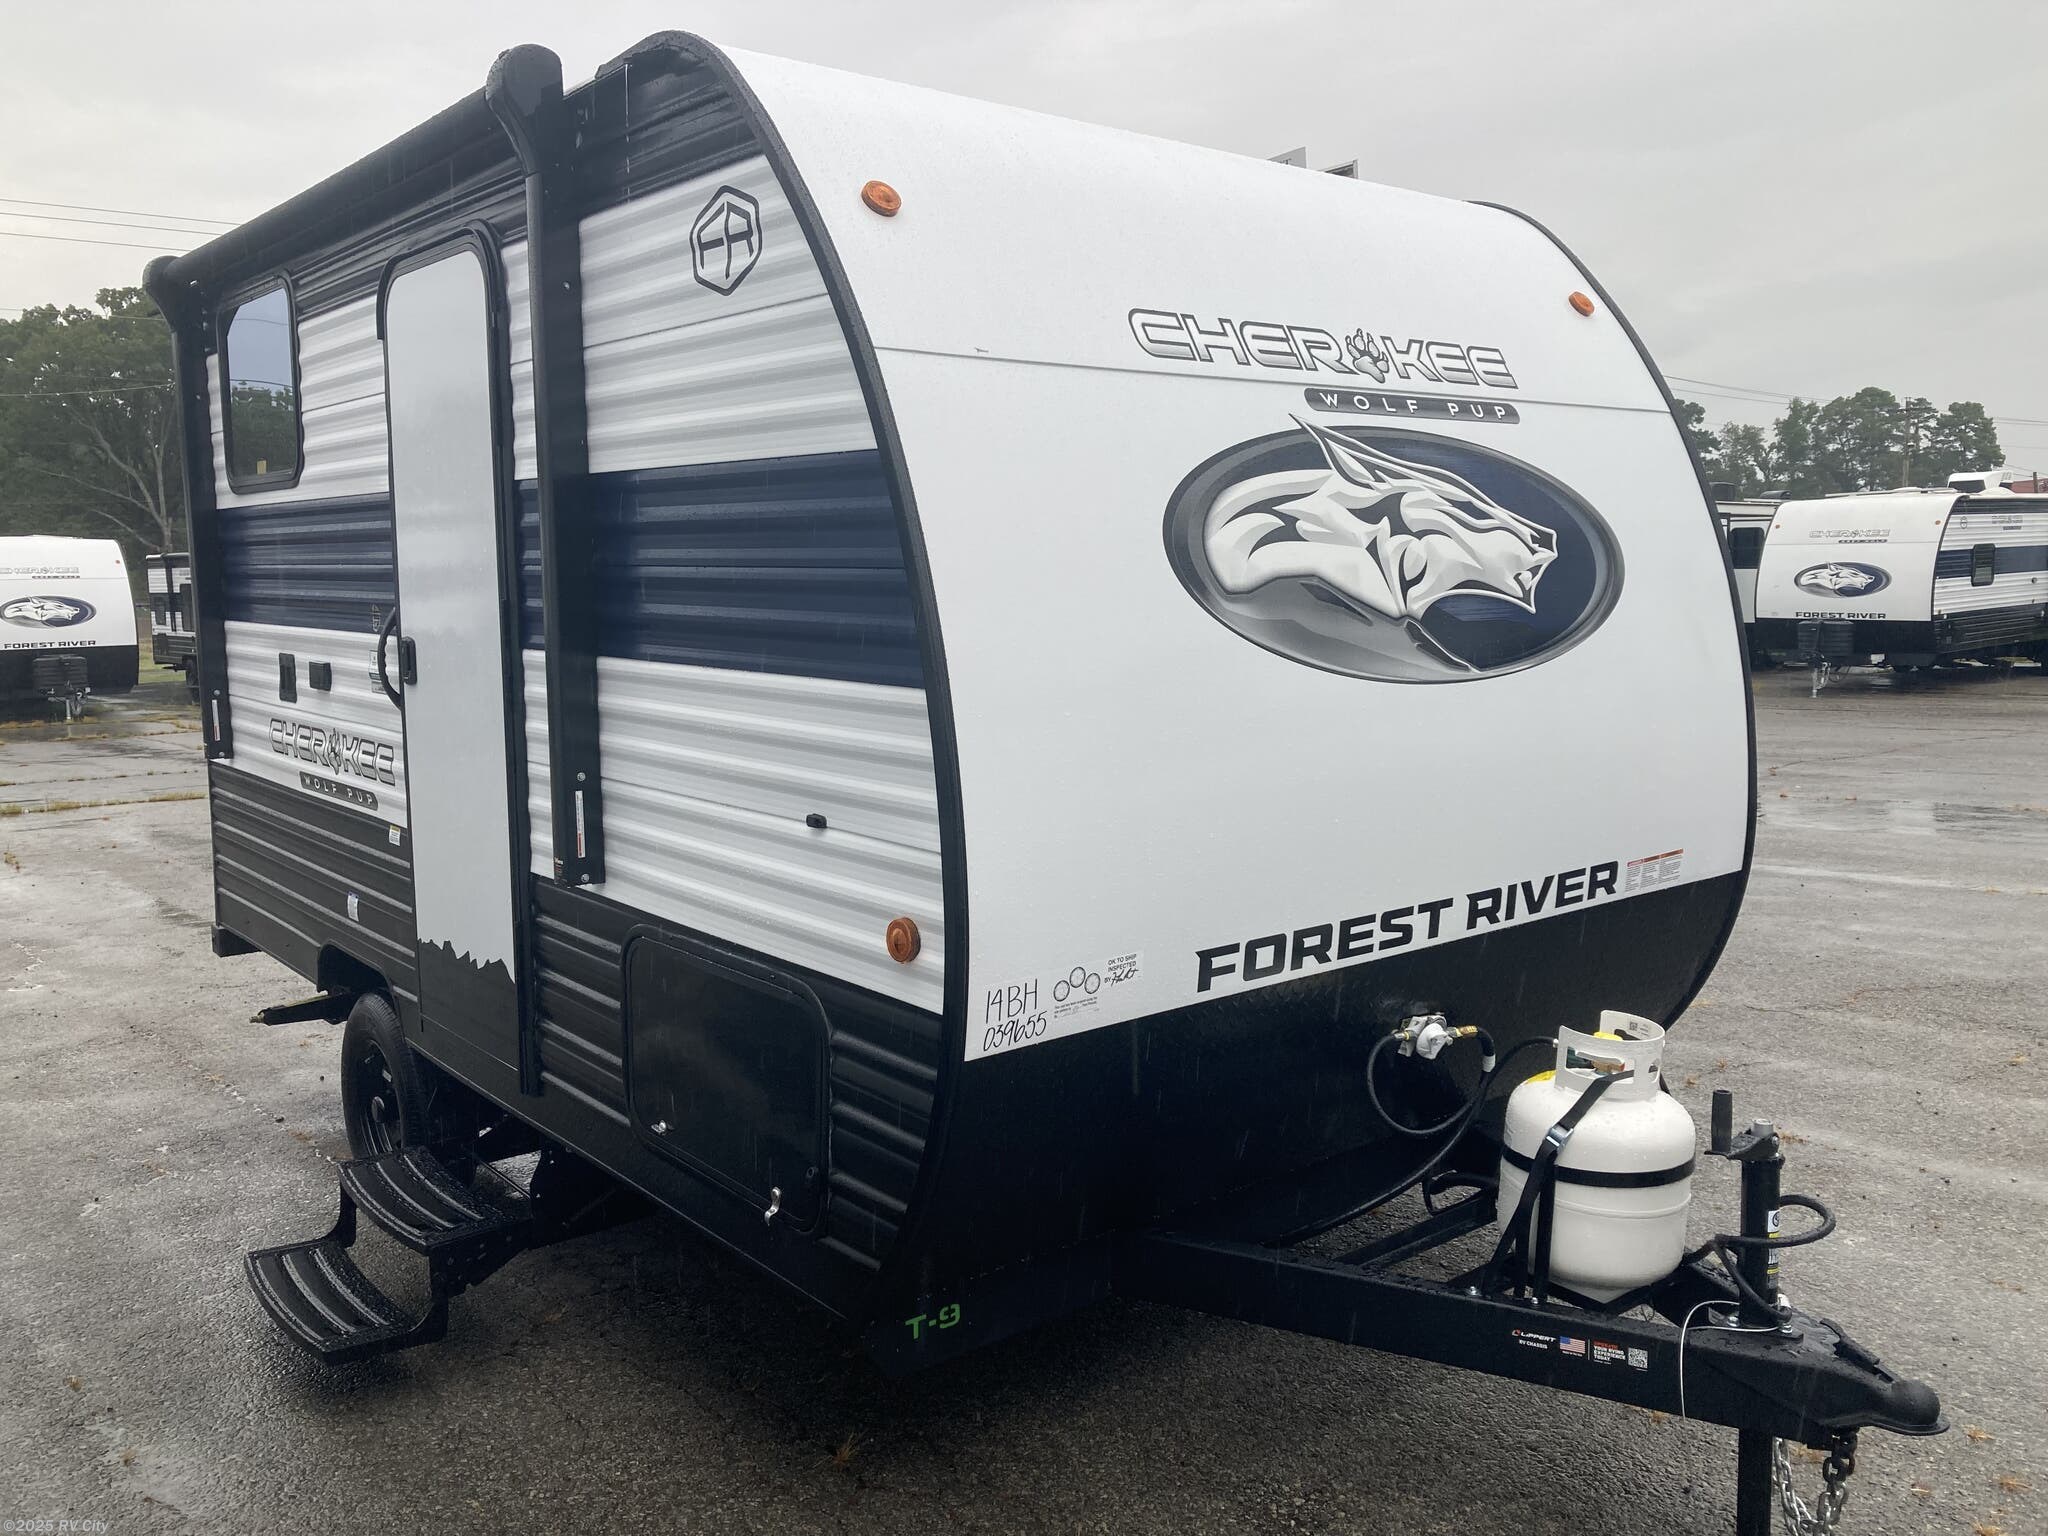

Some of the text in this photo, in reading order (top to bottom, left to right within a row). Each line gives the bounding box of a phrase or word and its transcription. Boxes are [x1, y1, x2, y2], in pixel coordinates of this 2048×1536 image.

[1128, 308, 1519, 390] CHEROKEE
[1319, 392, 1506, 419] WOLF PUP
[1795, 611, 1844, 619] FOREST
[270, 718, 396, 786] CHEROKEE
[304, 775, 373, 805] WOLF PUP
[1195, 897, 1453, 993] FOREST
[1466, 861, 1619, 930] RIVER
[983, 1010, 1048, 1052] 039655
[905, 1304, 960, 1340] T-9
[1520, 1332, 1557, 1342] LIPPERT
